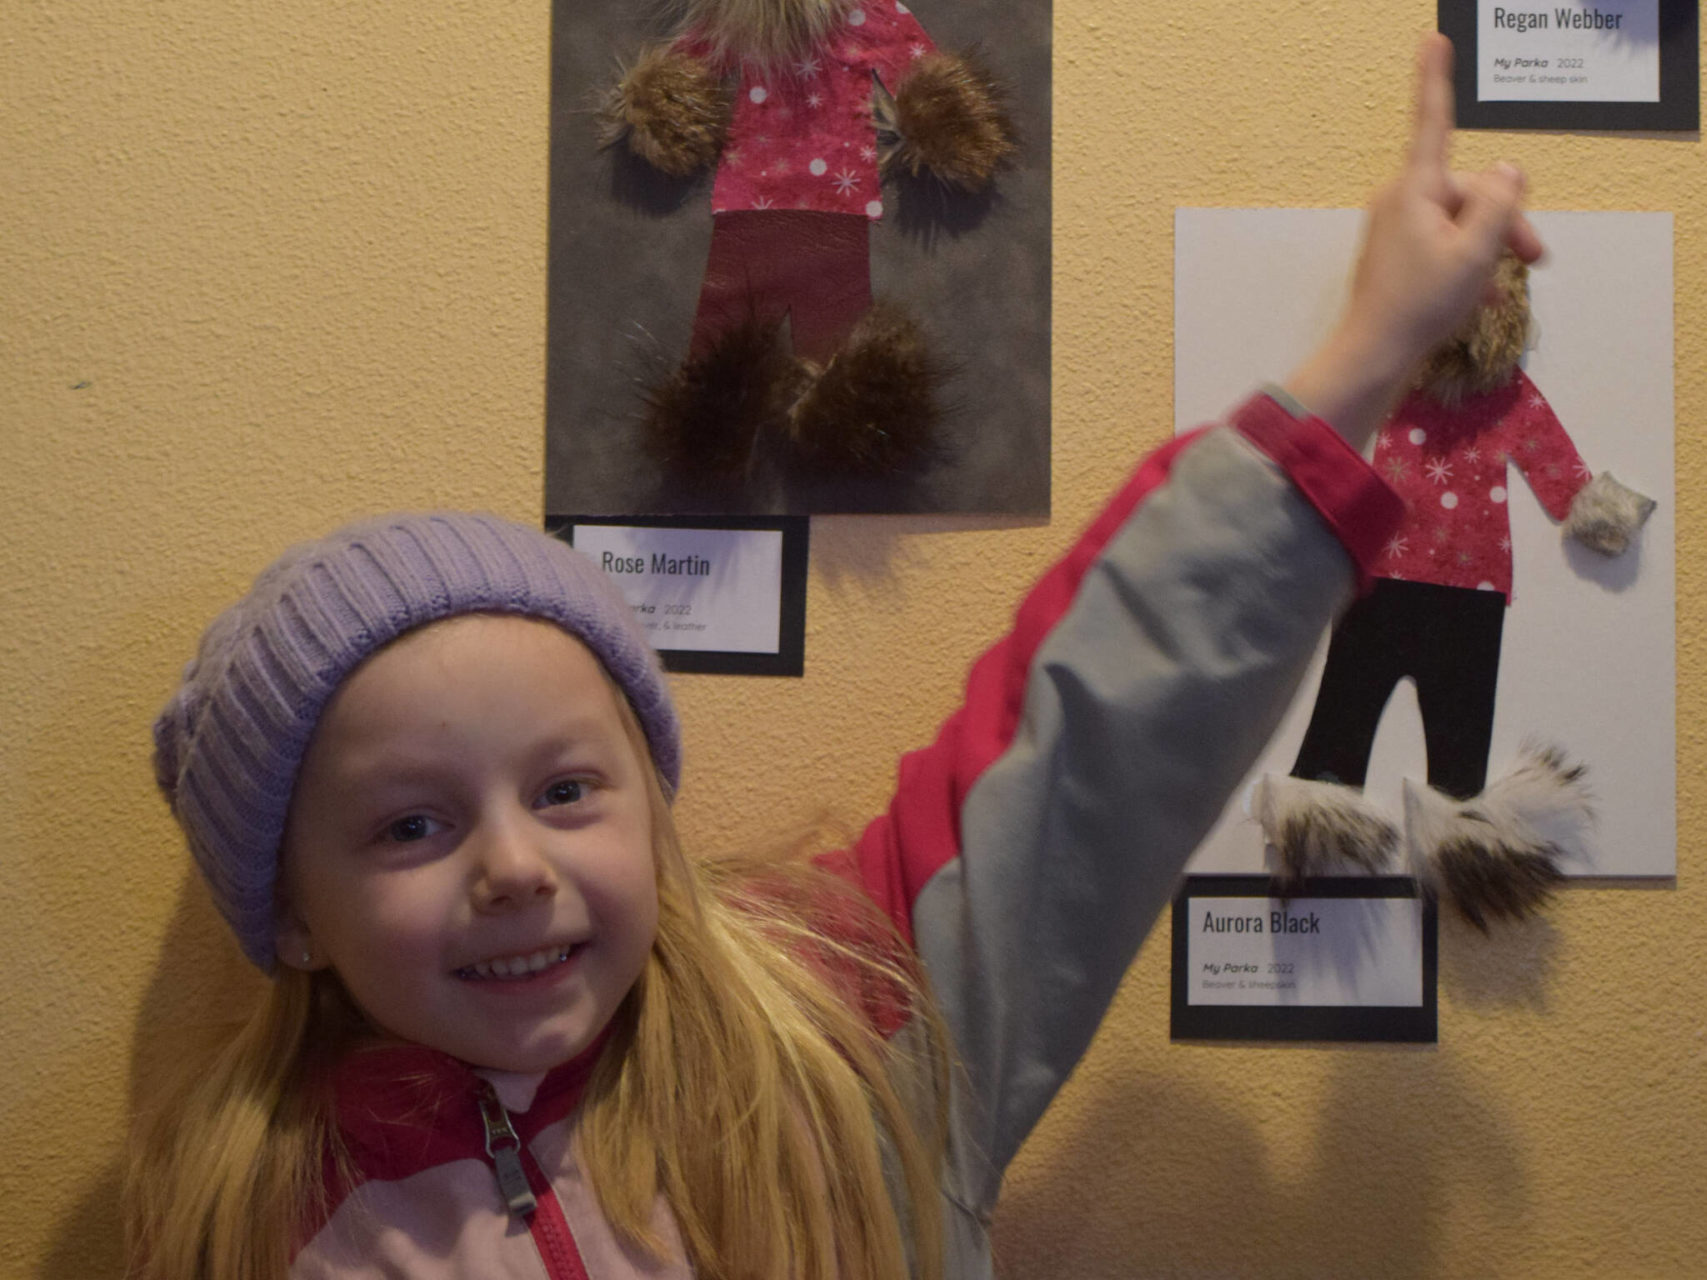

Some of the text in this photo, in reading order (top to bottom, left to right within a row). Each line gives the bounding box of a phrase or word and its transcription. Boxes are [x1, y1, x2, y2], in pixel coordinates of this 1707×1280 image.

[1494, 7, 1623, 32] Regan Webber
[1494, 57, 1584, 69] My Parka 2022
[1494, 74, 1588, 85] Beaver & sheep skin
[602, 551, 710, 576] Rose Martin
[664, 604, 692, 615] 2022
[673, 622, 707, 631] leather
[1202, 911, 1320, 934] Aurora Black
[1202, 963, 1295, 975] My Parka 2022
[1202, 980, 1236, 989] Beaver
[1238, 980, 1245, 989] &
